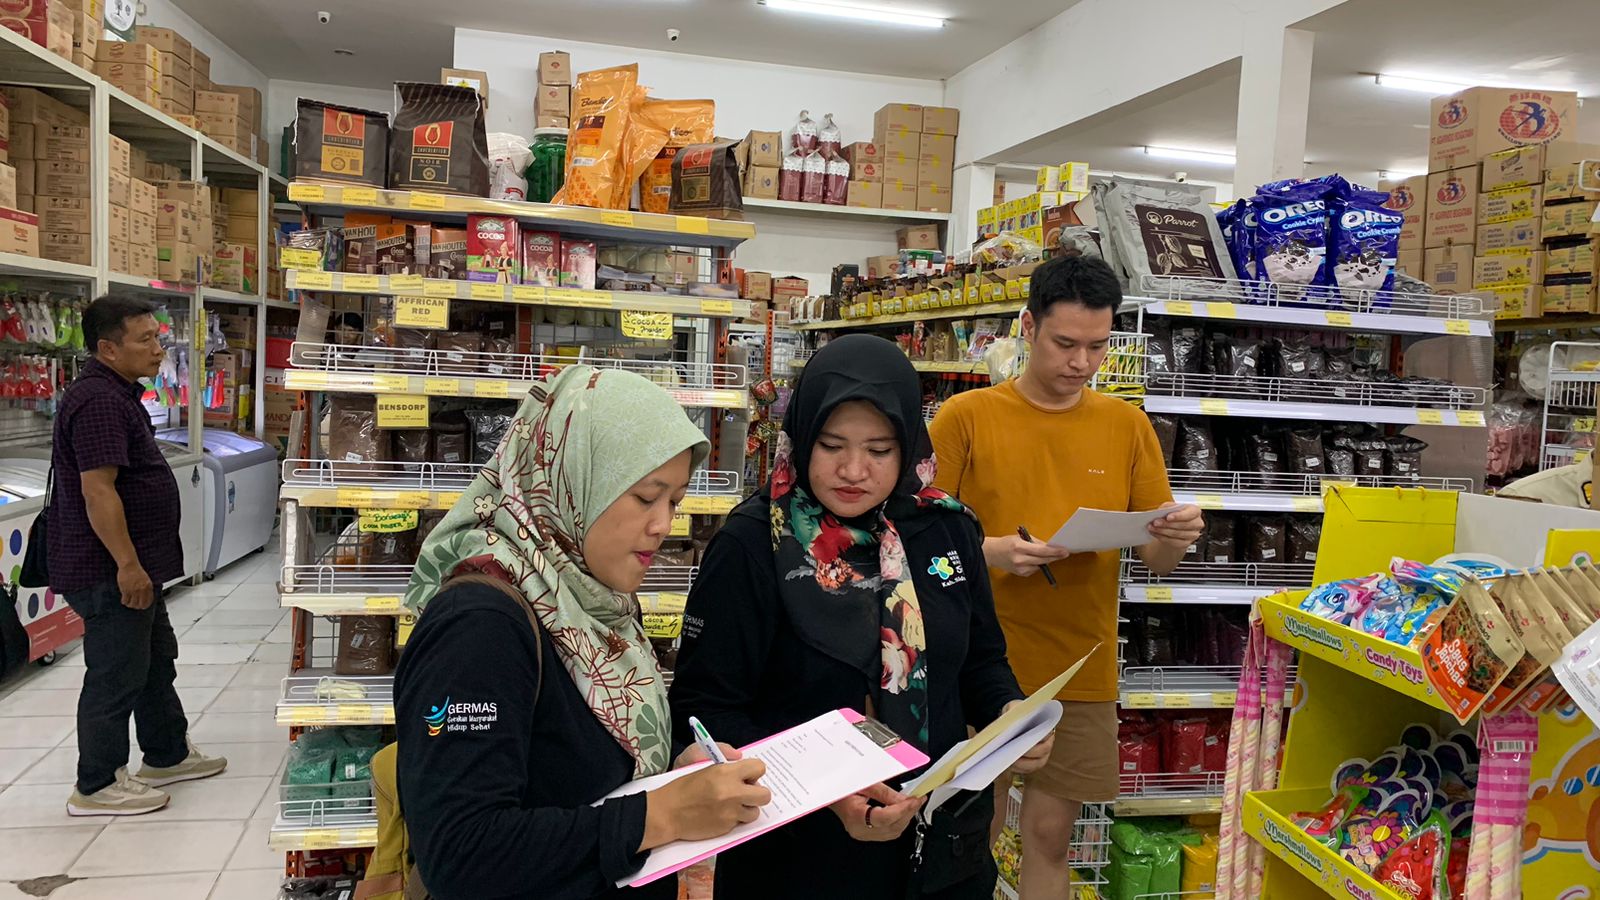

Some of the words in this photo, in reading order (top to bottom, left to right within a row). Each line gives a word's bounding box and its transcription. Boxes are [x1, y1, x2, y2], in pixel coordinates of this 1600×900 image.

[1262, 199, 1326, 223] OREO
[1162, 214, 1200, 228] Parrot
[1282, 220, 1308, 230] Cookie
[1340, 209, 1402, 229] OREO
[344, 228, 358, 238] VAN
[359, 225, 376, 237] HOU
[1357, 229, 1380, 239] Cookie
[398, 297, 445, 307] AFFRICAN
[411, 307, 431, 316] RED
[378, 403, 426, 412] BENSDORP
[1285, 615, 1343, 649] Marshmallows
[1365, 647, 1398, 675] Candy
[1397, 660, 1424, 683] Toys
[1450, 638, 1468, 671] Saus
[1434, 642, 1466, 688] Japchae
[447, 702, 497, 714] GERMAS
[447, 724, 468, 732] Hidup
[470, 723, 491, 731] Sehat
[1264, 818, 1323, 871] Marshmallows
[1344, 878, 1374, 900] Cand
